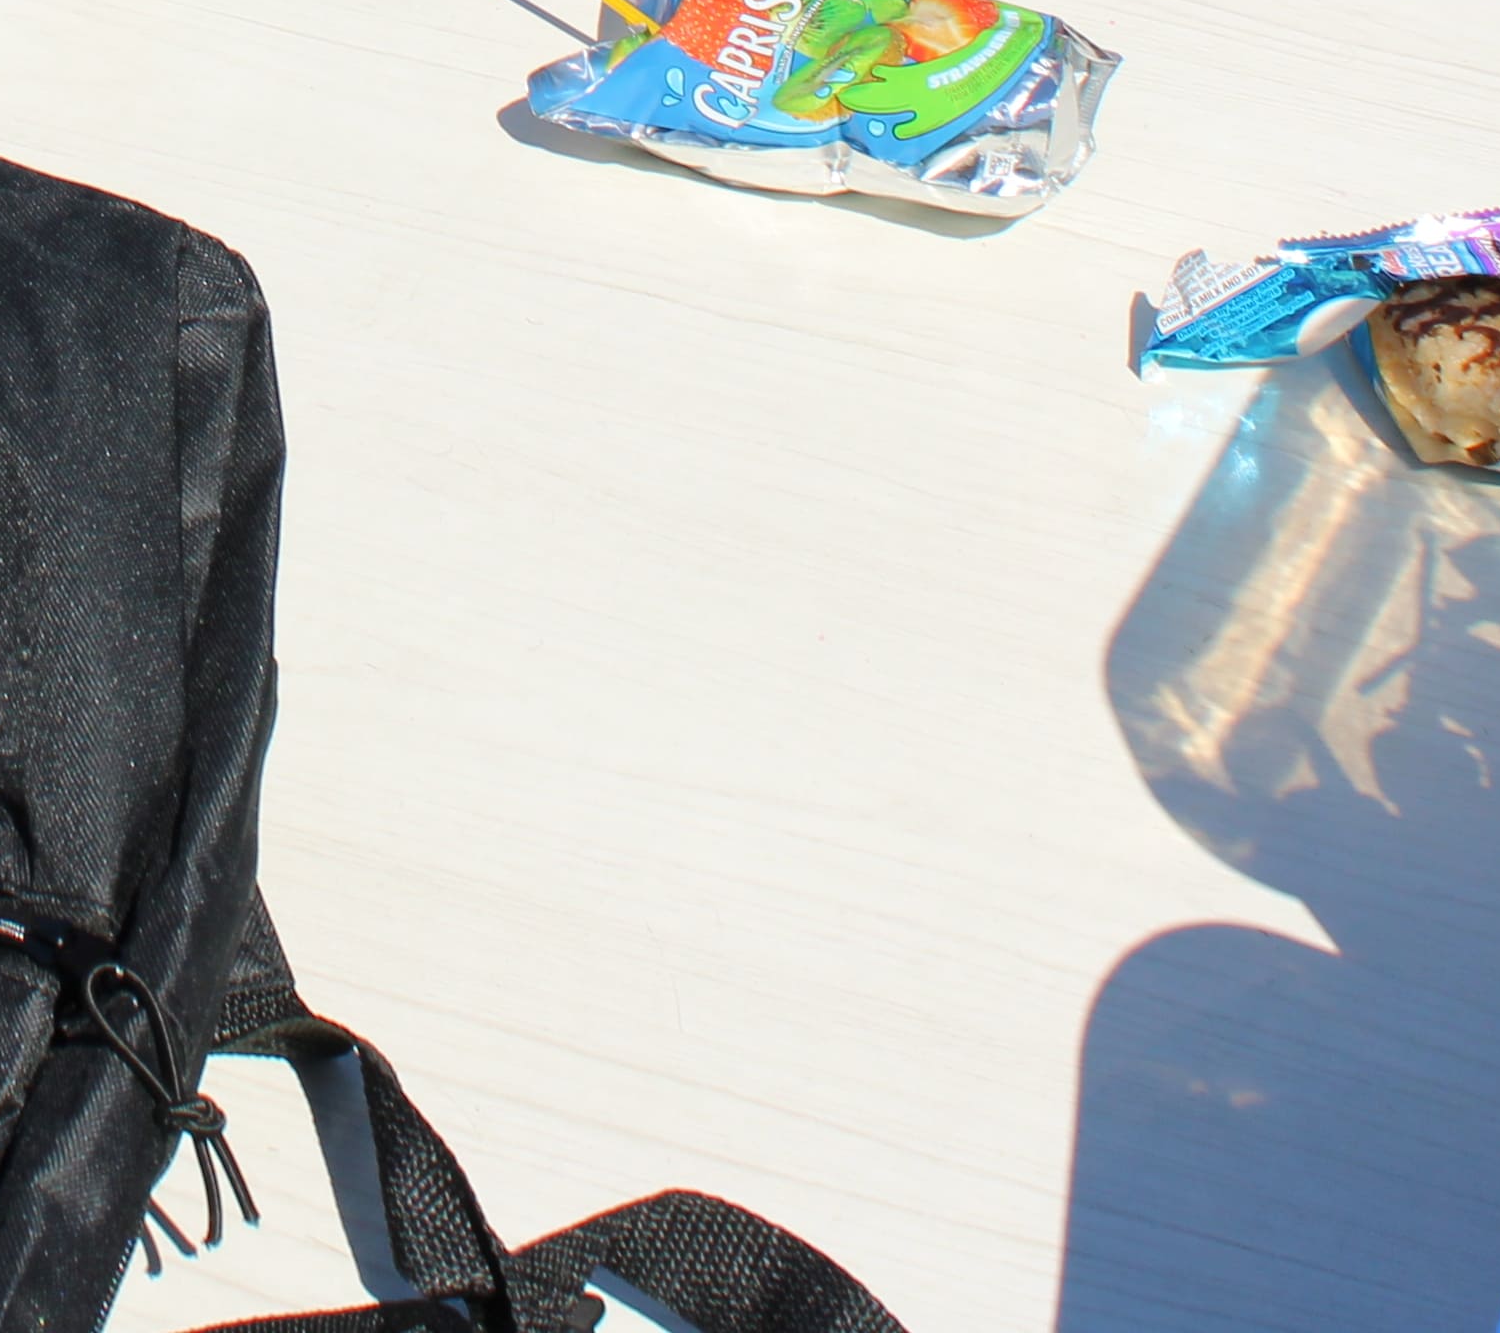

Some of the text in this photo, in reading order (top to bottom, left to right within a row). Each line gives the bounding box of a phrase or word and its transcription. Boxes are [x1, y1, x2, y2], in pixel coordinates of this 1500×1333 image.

[1159, 261, 1260, 328] CONTAS MILK AND SOY
